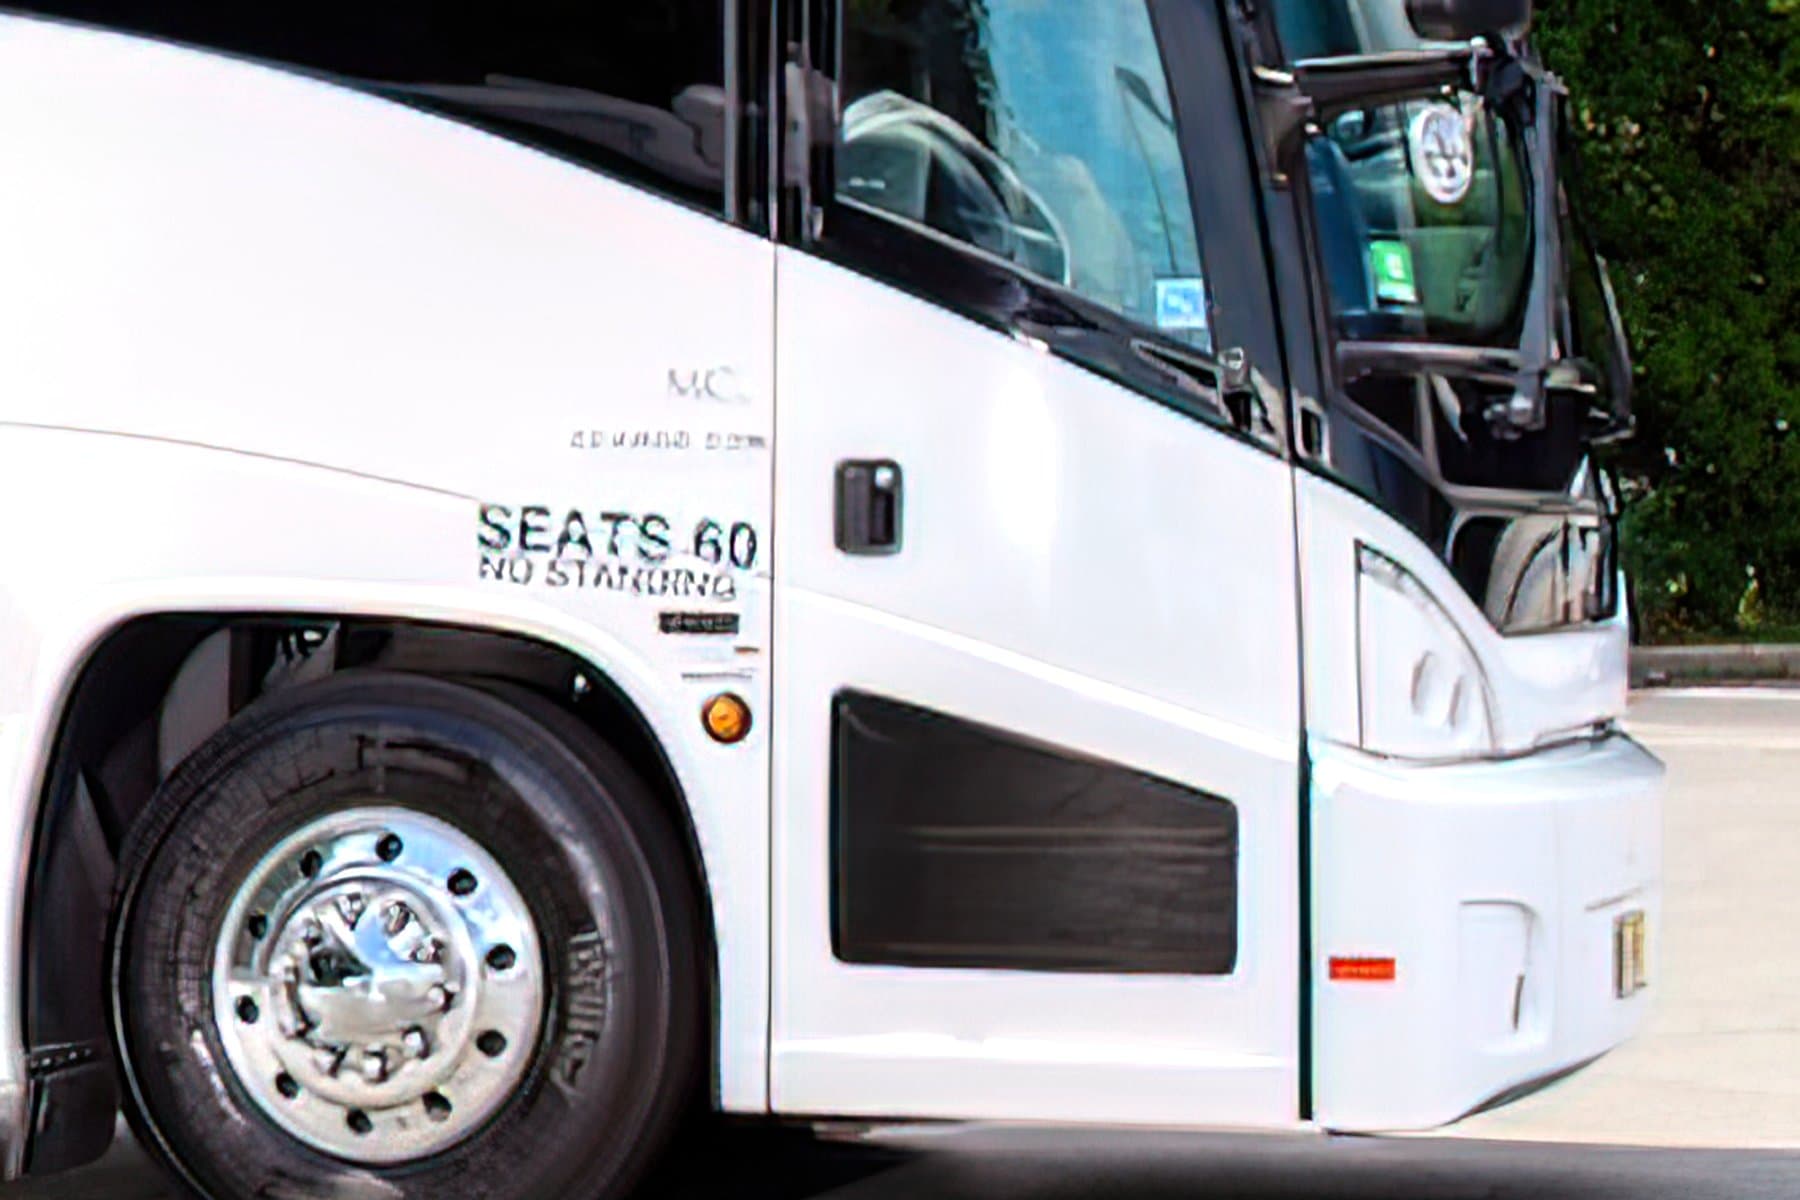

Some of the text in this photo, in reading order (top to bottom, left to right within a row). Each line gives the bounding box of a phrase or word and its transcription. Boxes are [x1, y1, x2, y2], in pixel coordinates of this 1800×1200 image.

[477, 503, 758, 571] SEATS 60
[478, 554, 533, 586] NO
